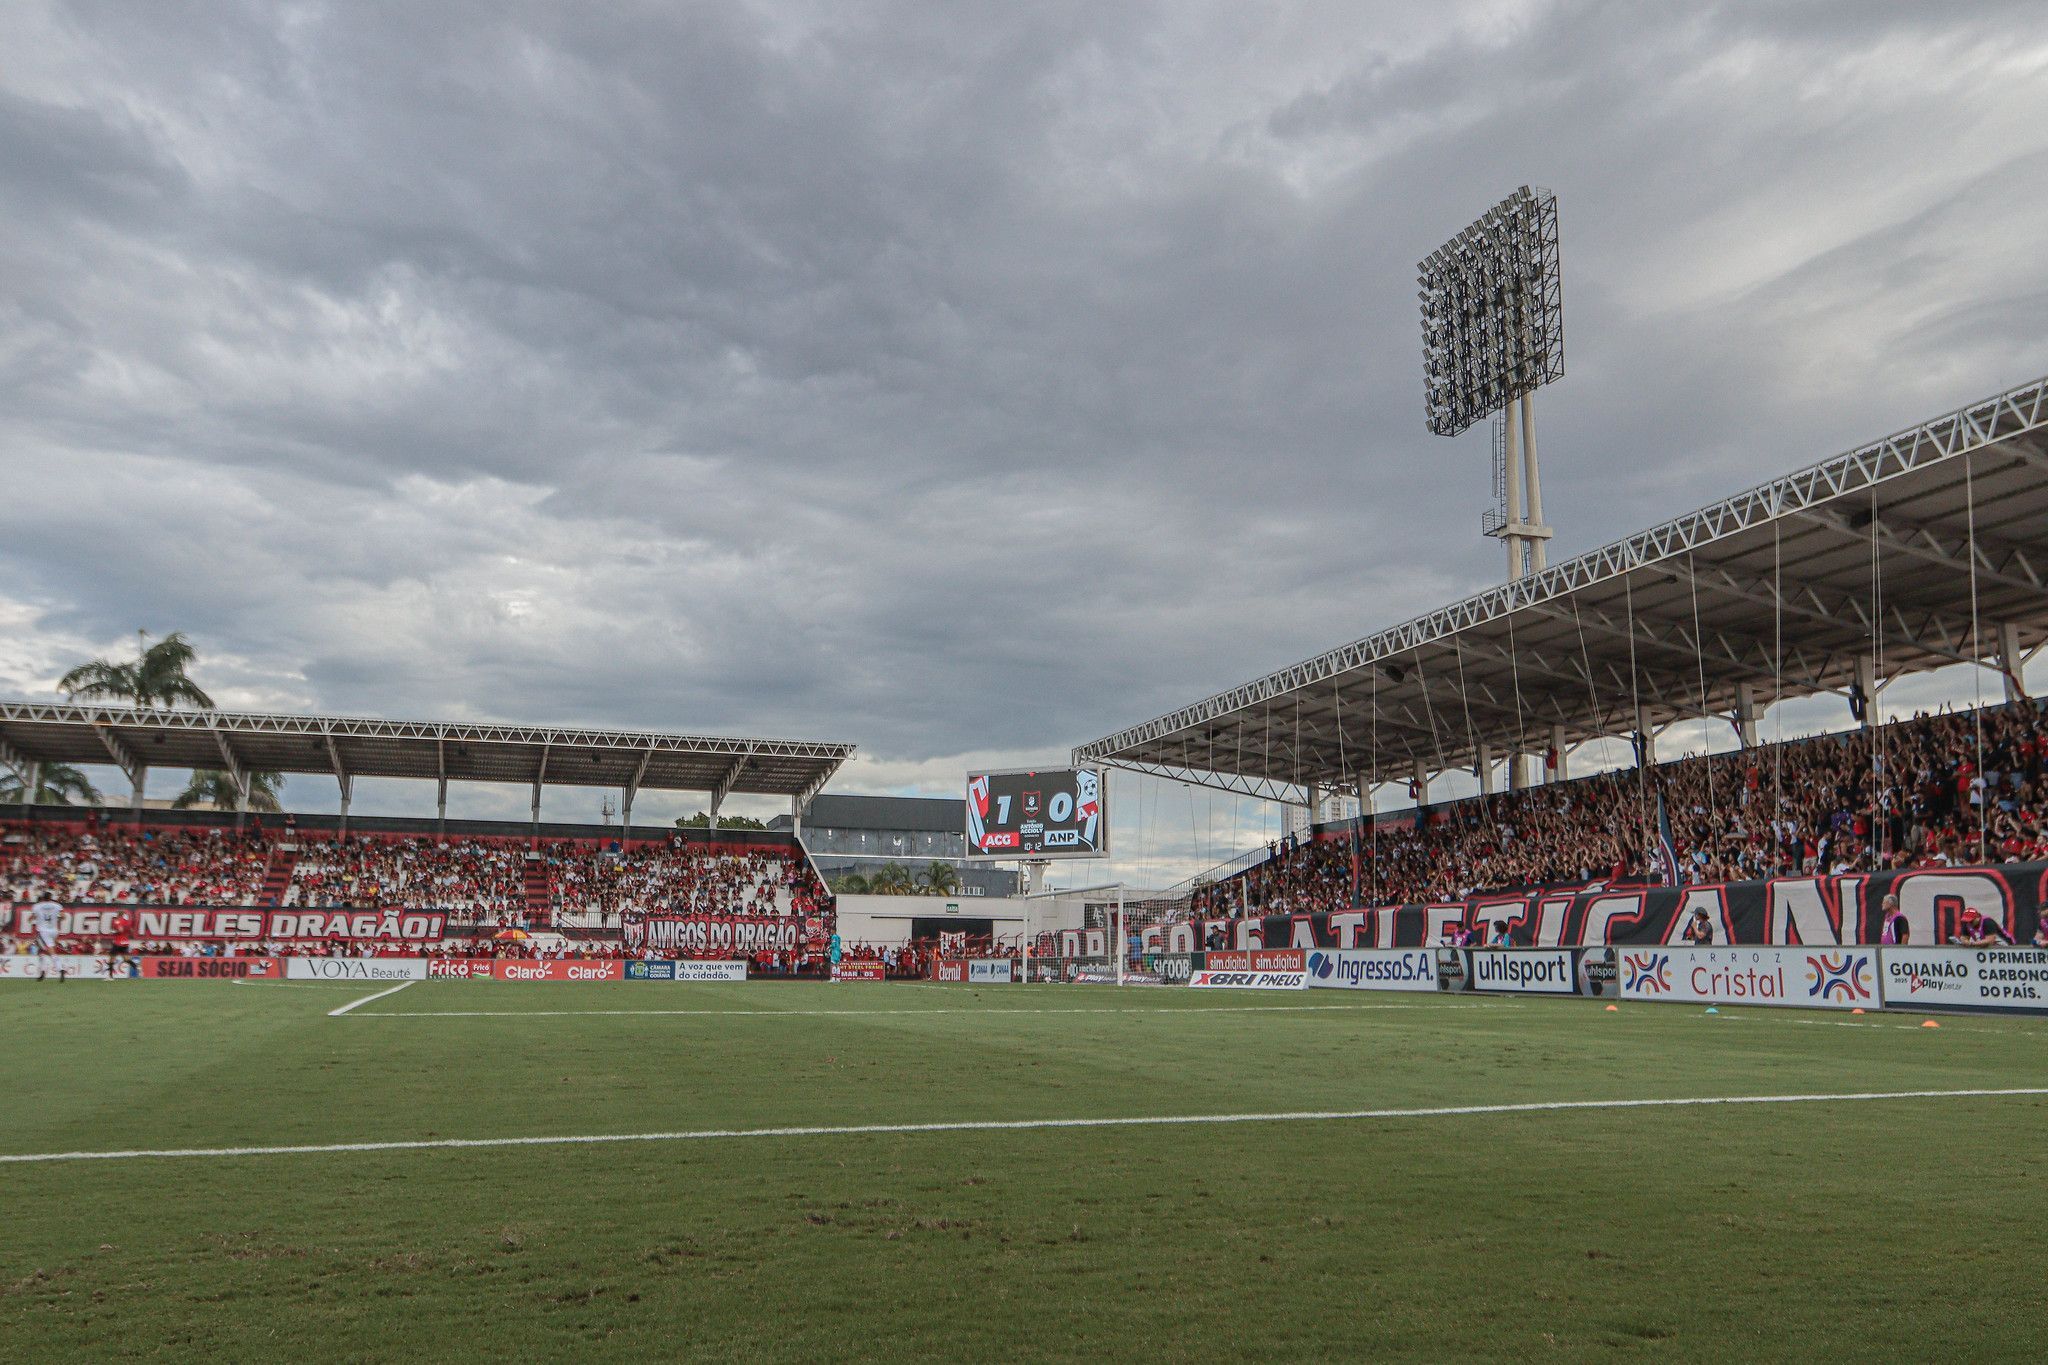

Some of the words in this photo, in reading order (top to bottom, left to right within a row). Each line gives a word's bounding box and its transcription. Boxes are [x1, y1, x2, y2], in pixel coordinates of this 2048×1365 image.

[997, 795, 1012, 825] 1
[1048, 792, 1074, 823] 0
[985, 835, 1011, 846] ACG
[1048, 832, 1075, 844] ANP
[138, 912, 263, 938] NELES
[270, 910, 442, 939] DRAGÃO!
[648, 920, 707, 950] AMIGOS
[710, 922, 732, 951] DO
[1210, 956, 1249, 971] sim.digita
[1255, 954, 1301, 972] sim.digital
[1690, 952, 1781, 963] ARROZ
[1976, 952, 1986, 963] O
[1989, 952, 2048, 964] PRIMEIR
[157, 961, 193, 977] SEJA
[197, 960, 248, 977] SÓCIO
[307, 959, 369, 978] VOYA
[371, 967, 411, 979] Beauté
[505, 966, 546, 980] Claro
[567, 966, 608, 980] Claro
[678, 971, 690, 979] do
[679, 962, 686, 970] A
[706, 963, 722, 972] que
[939, 961, 961, 981] Eternit
[1479, 953, 1567, 989] uhlsport
[1890, 960, 1968, 978] GOIANÃO
[1978, 969, 2048, 982] CARBONO
[1194, 973, 1258, 986] XBRI
[1258, 974, 1305, 987] PNEUS
[1691, 966, 1784, 998] Cristal
[1980, 985, 2000, 997] DO
[2003, 983, 2041, 999] PAÍS.
